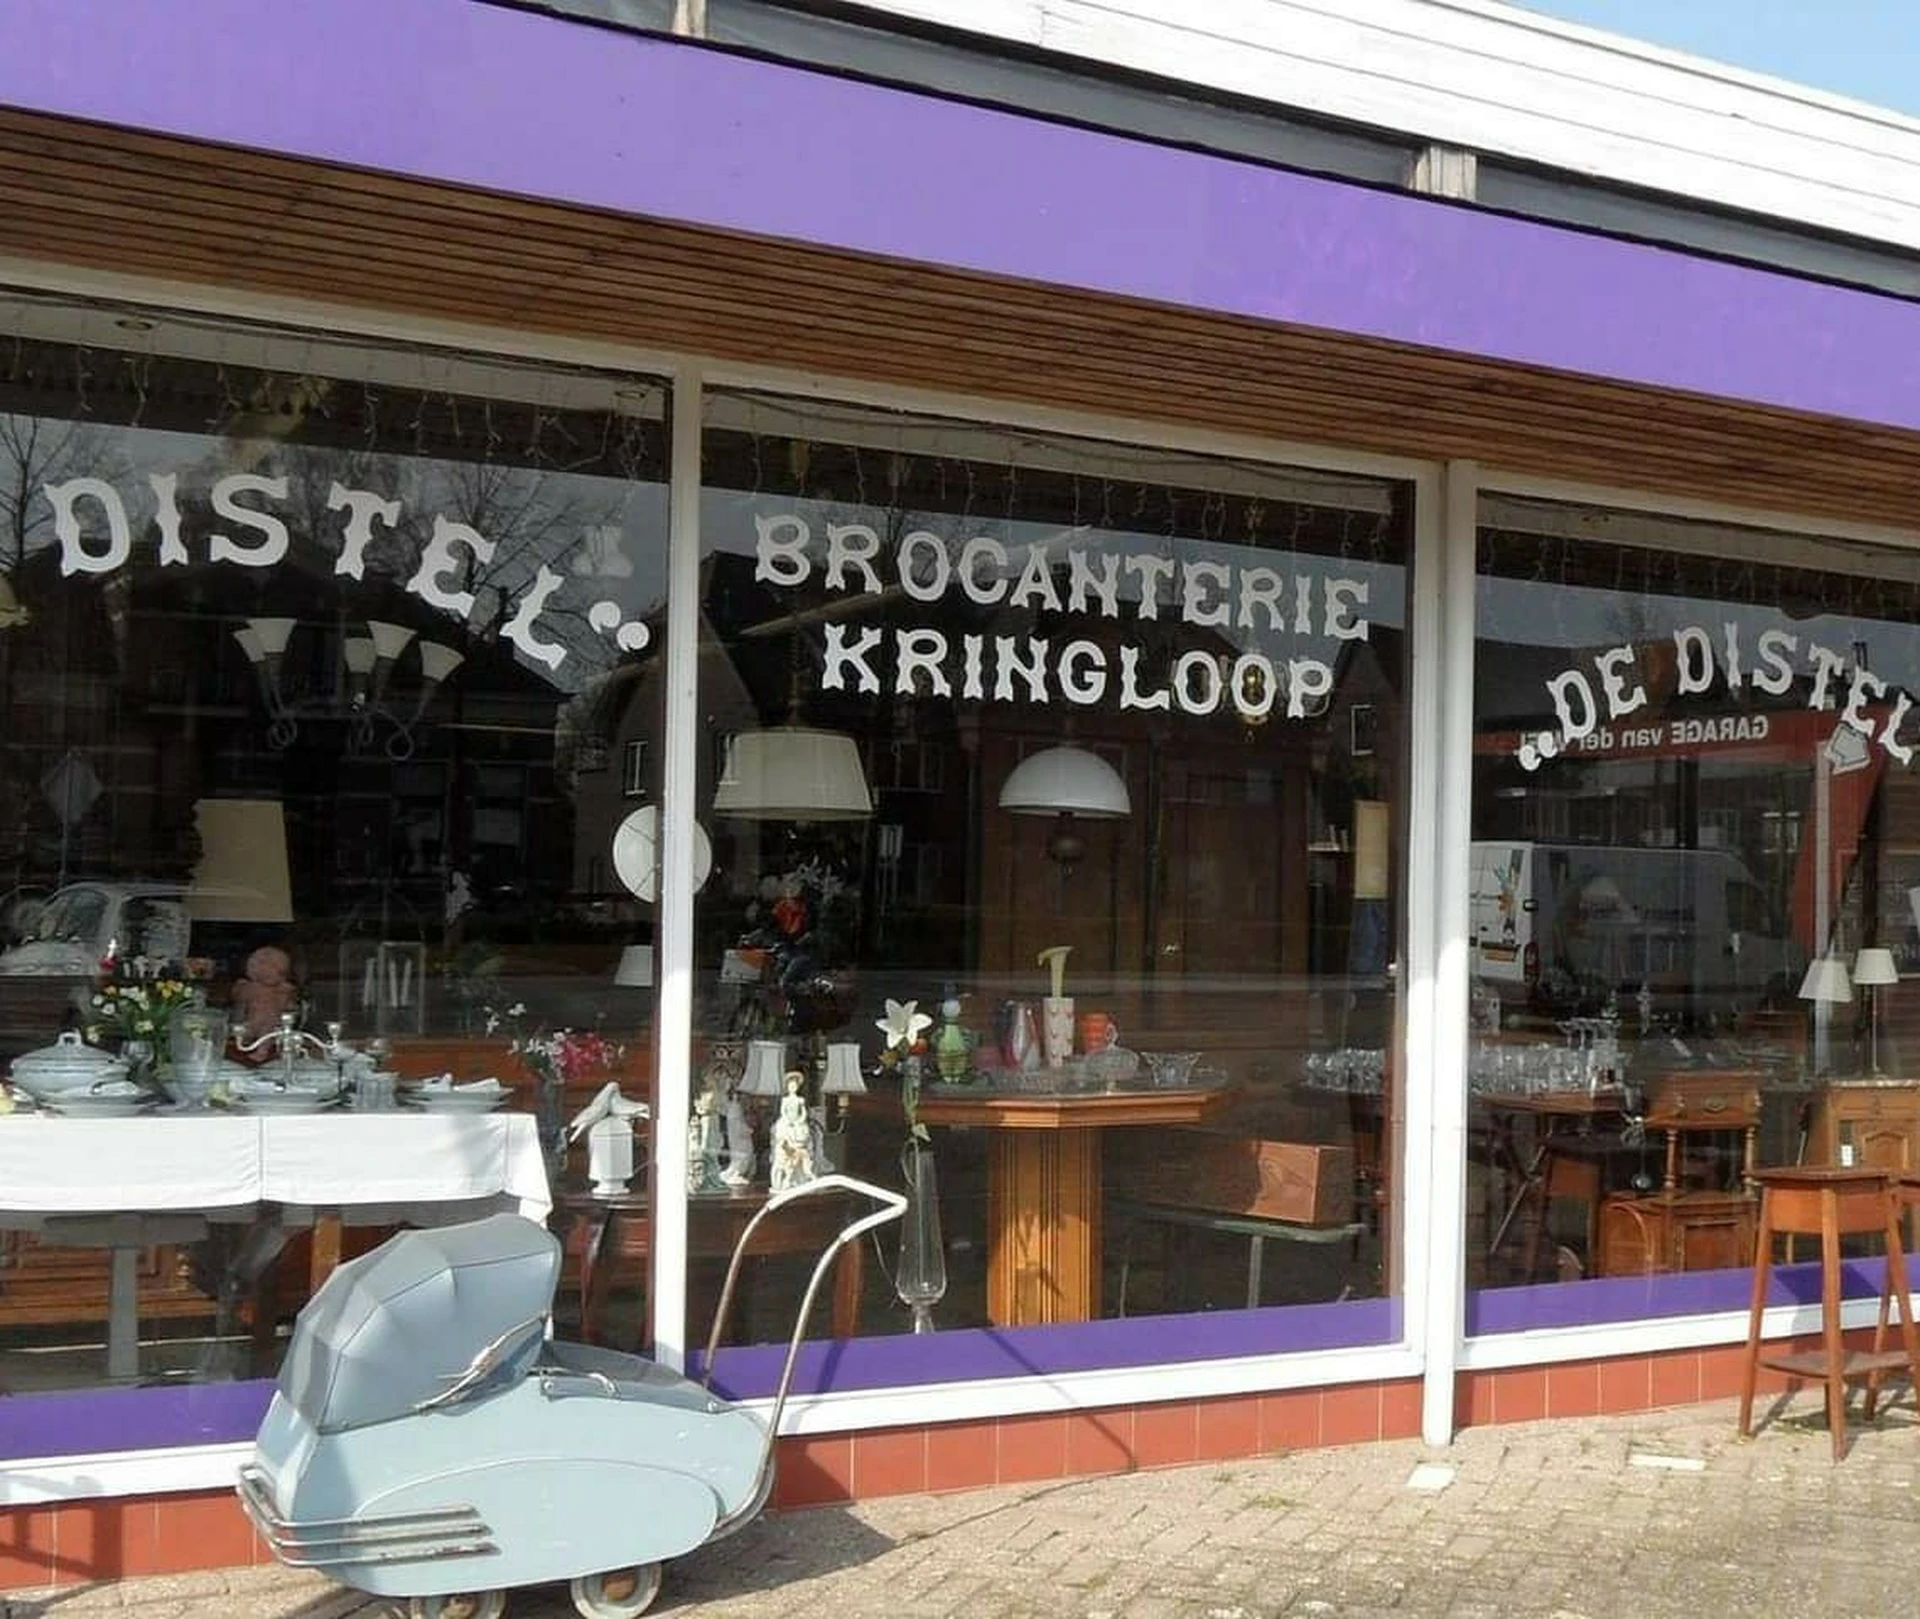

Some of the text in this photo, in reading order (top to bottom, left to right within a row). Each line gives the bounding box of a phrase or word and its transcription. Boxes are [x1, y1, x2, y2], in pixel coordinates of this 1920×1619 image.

[754, 513, 1368, 641] BROCANTERIE
[821, 623, 1333, 717] KRINGLOOP
[1673, 621, 1912, 765] DISTEL
